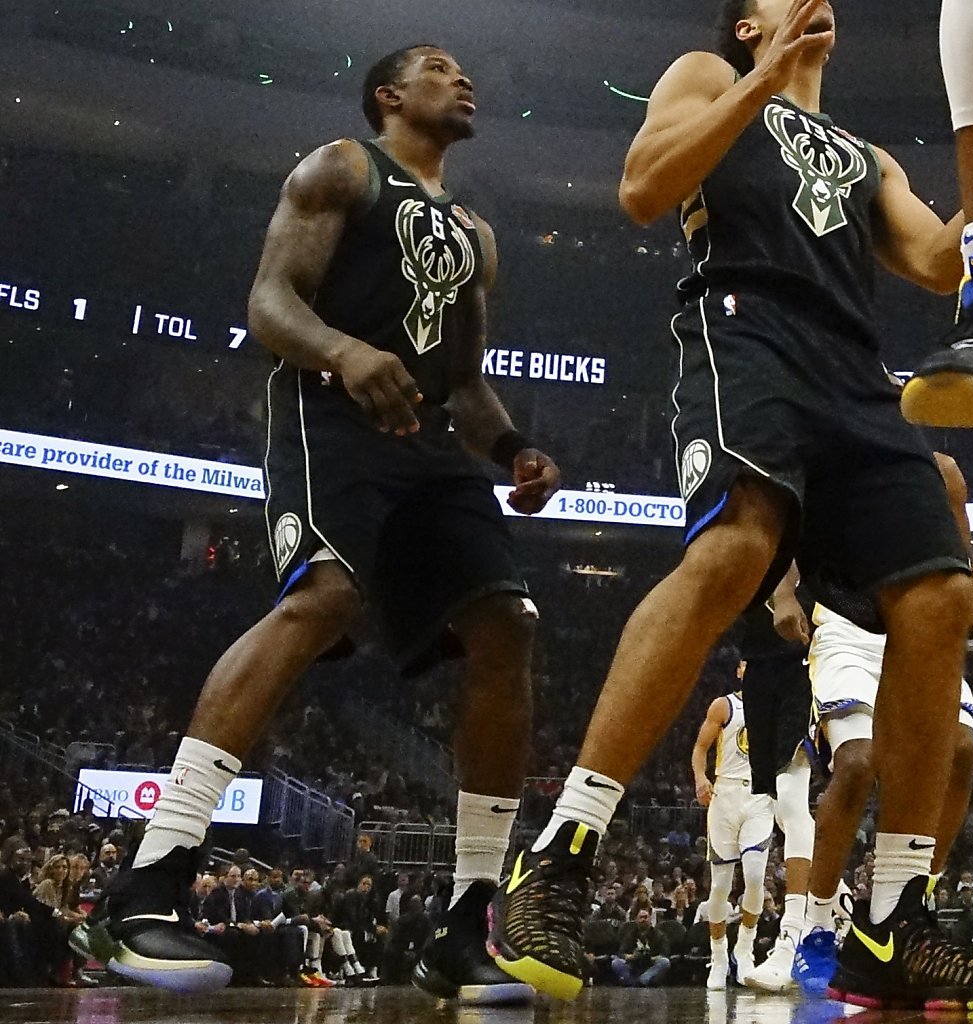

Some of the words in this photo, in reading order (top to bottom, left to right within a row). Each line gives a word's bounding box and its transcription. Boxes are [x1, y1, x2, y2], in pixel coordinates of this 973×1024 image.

[799, 115, 829, 143] 13
[73, 298, 87, 320] 1
[155, 313, 197, 340] TOL
[228, 326, 247, 349] 7
[529, 352, 606, 384] BUCKS
[0, 439, 36, 460] are
[41, 447, 132, 473] provider
[138, 459, 159, 476] of
[164, 463, 196, 482] the
[200, 467, 263, 492] Milwa
[558, 496, 684, 520] 1-800-DOCTO
[94, 788, 129, 803] BMO
